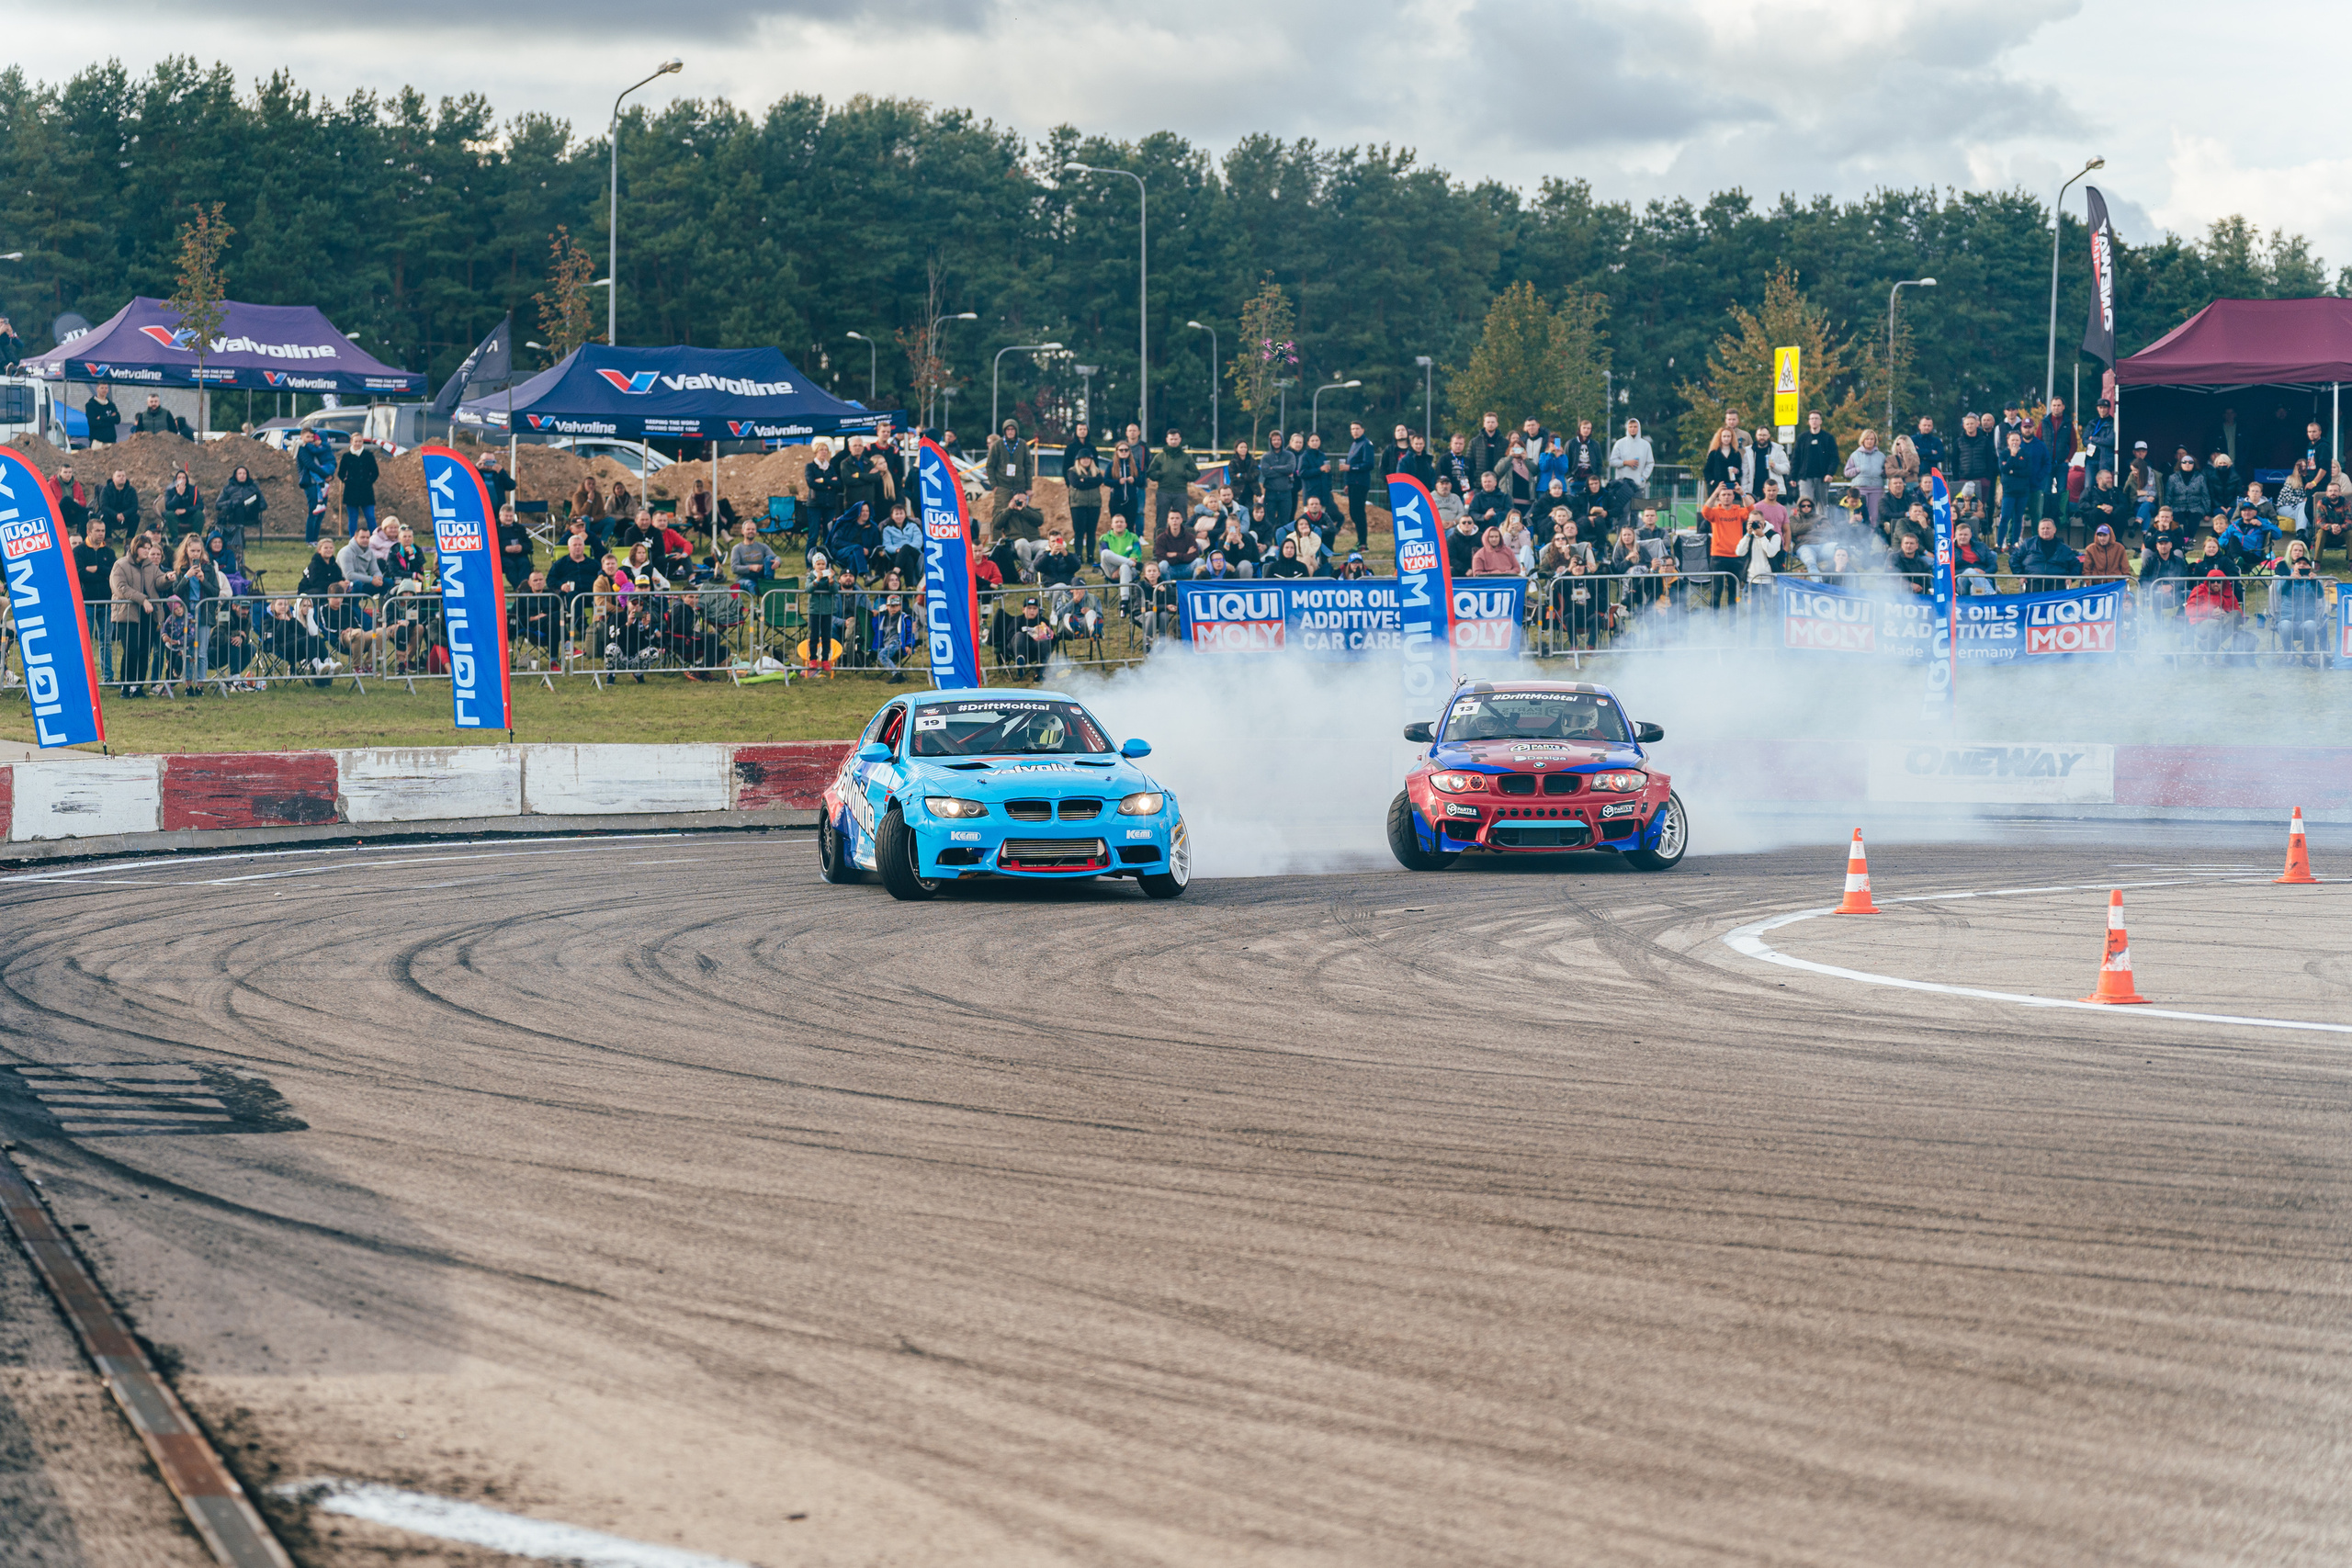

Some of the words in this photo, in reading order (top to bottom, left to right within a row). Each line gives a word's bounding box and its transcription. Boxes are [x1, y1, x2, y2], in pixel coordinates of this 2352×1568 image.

[209, 336, 336, 359] Valvoline
[109, 368, 163, 380] Valvoline
[287, 377, 337, 389] Valvoline
[661, 373, 794, 396] Valvoline
[555, 421, 616, 434] Valvoline
[753, 424, 813, 437] Valvoline
[1194, 592, 1279, 621] LIQUI
[1291, 590, 1364, 608] MOTOR
[1368, 589, 1400, 607] OIL
[1453, 592, 1510, 619] QUI
[1790, 592, 1870, 623] LIQUI
[1968, 604, 2019, 621] OILS
[2031, 595, 2114, 626] LIQUI
[1196, 623, 1283, 650] MOLY
[1304, 632, 1346, 650] CAR
[1455, 621, 1510, 647] OLY
[1791, 620, 1871, 649] MOLY
[1883, 622, 1899, 637] &
[2031, 624, 2114, 651] MOLY
[1884, 644, 1924, 658] Made
[1958, 647, 2017, 660] ermany
[981, 762, 1096, 776] Valvoline
[1905, 745, 2085, 777] ONEWAY
